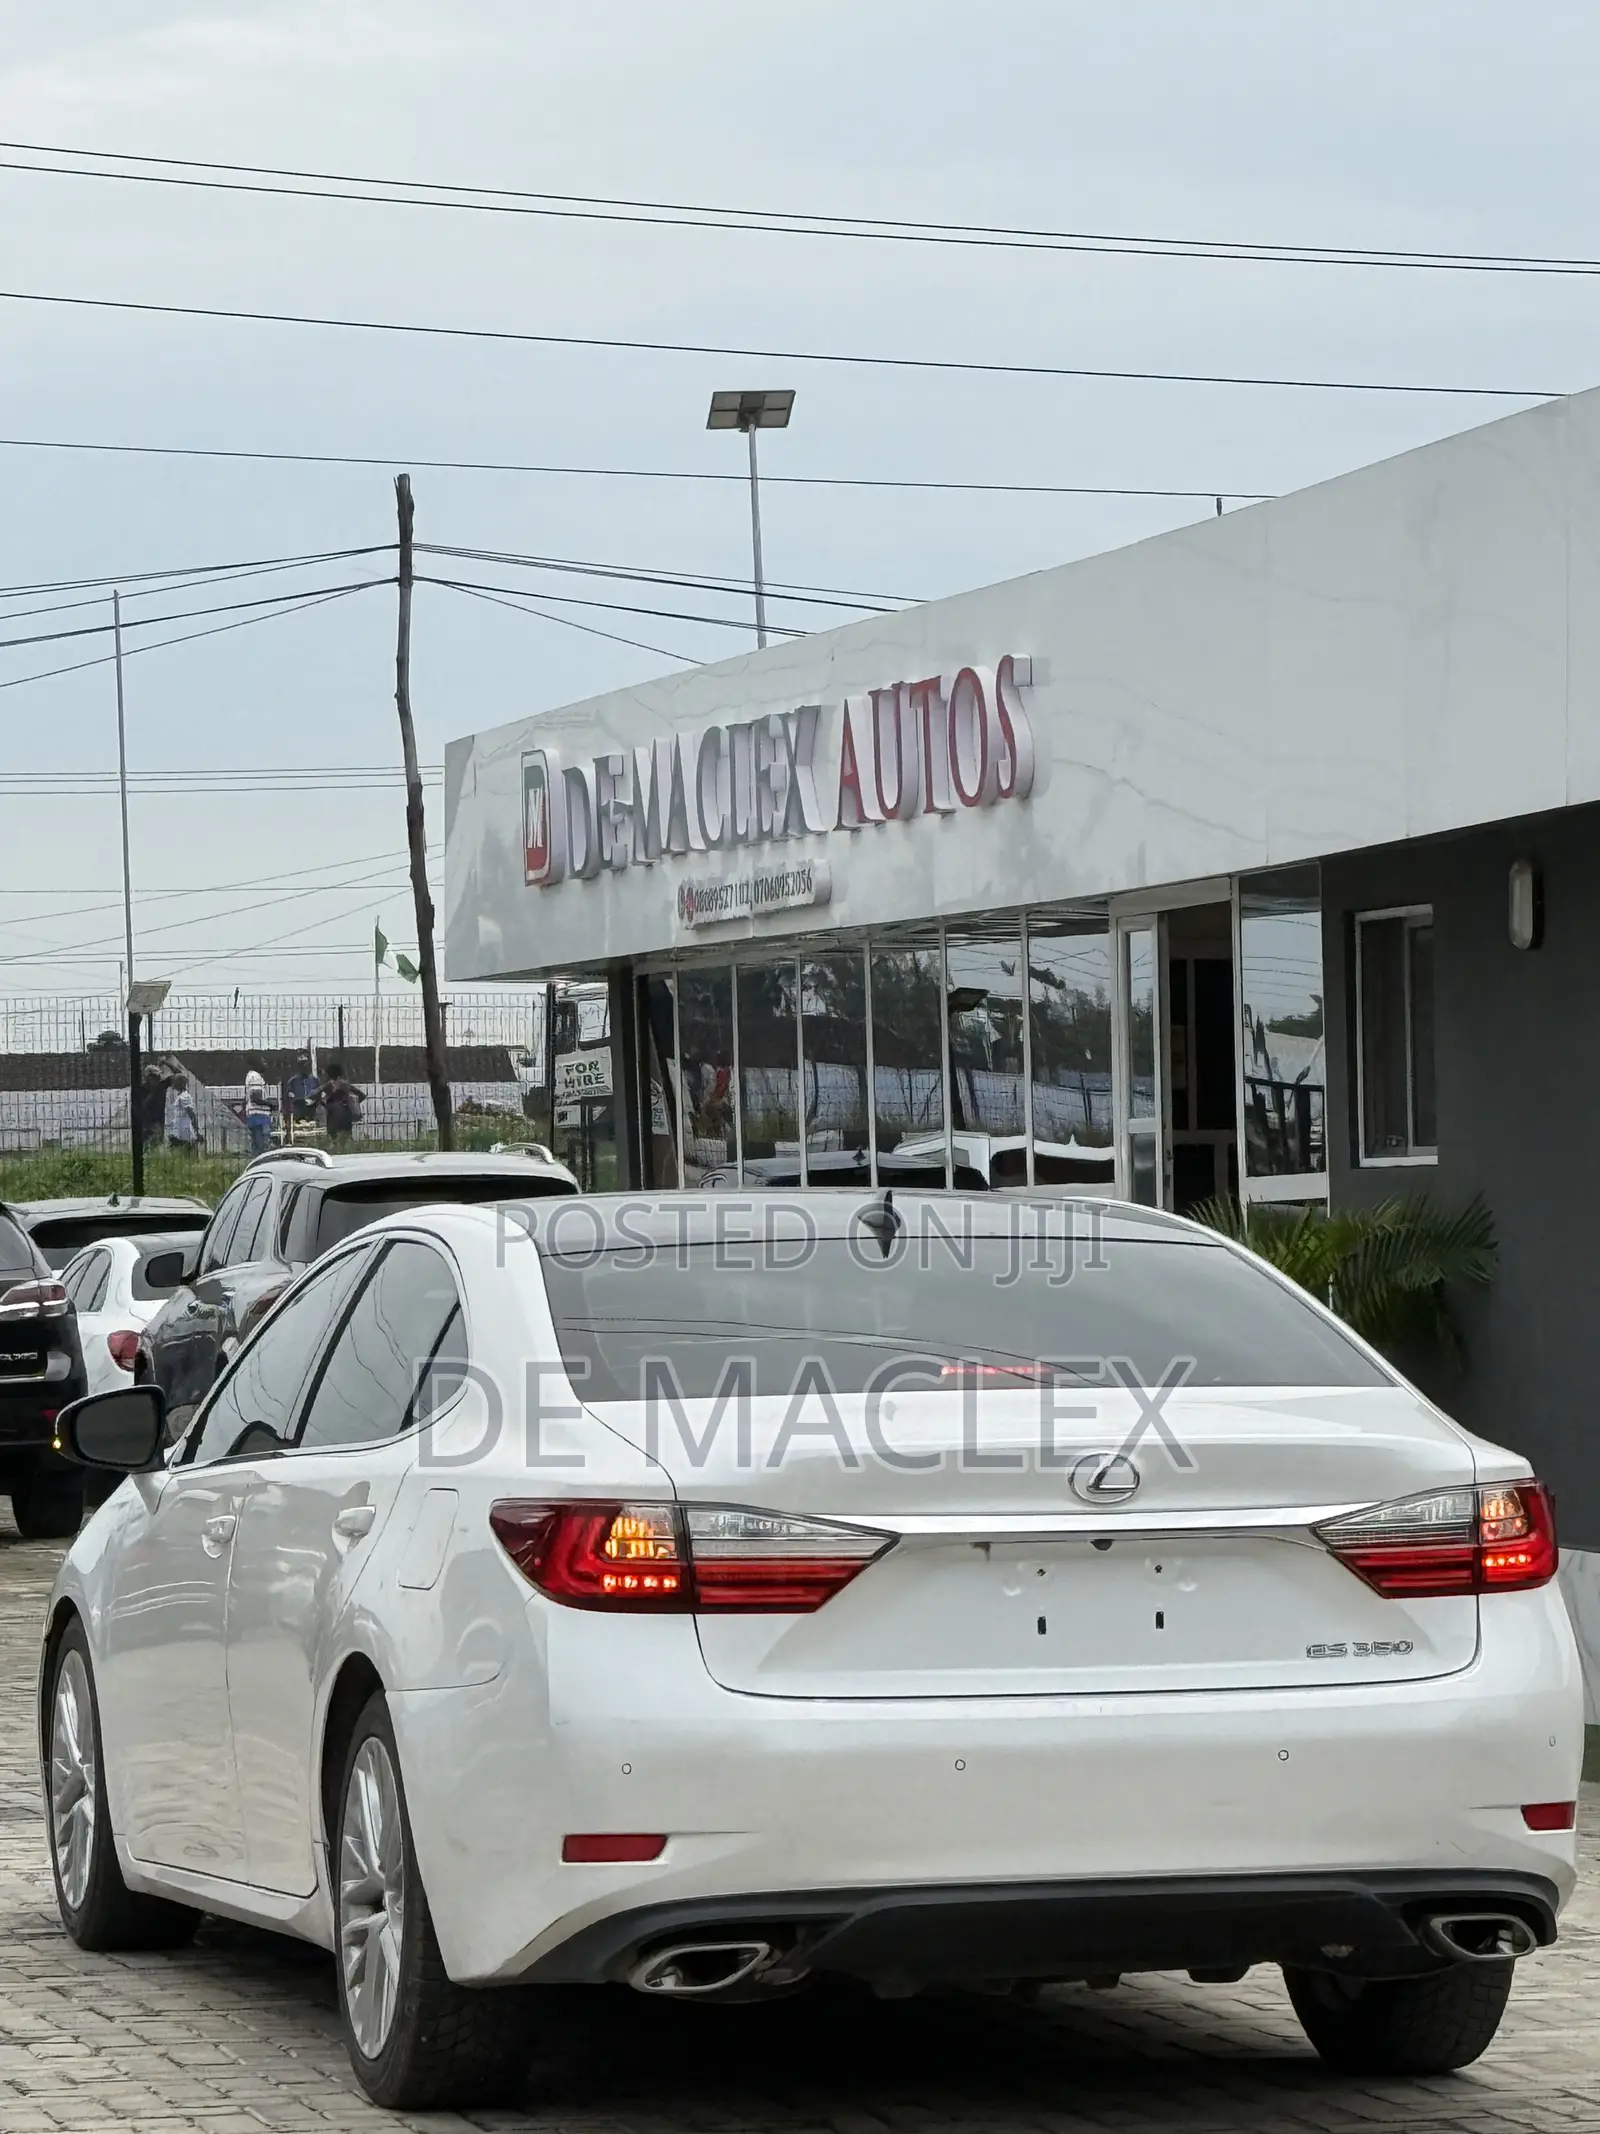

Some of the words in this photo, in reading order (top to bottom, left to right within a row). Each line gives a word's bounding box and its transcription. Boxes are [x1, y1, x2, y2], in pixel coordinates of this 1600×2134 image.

[562, 705, 827, 879] DEMACLEX
[832, 654, 1034, 832] AUTOS
[564, 1060, 600, 1075] FOR
[564, 1073, 605, 1088] HIRE
[1306, 1643, 1348, 1659] ES
[1352, 1640, 1414, 1657] 350
